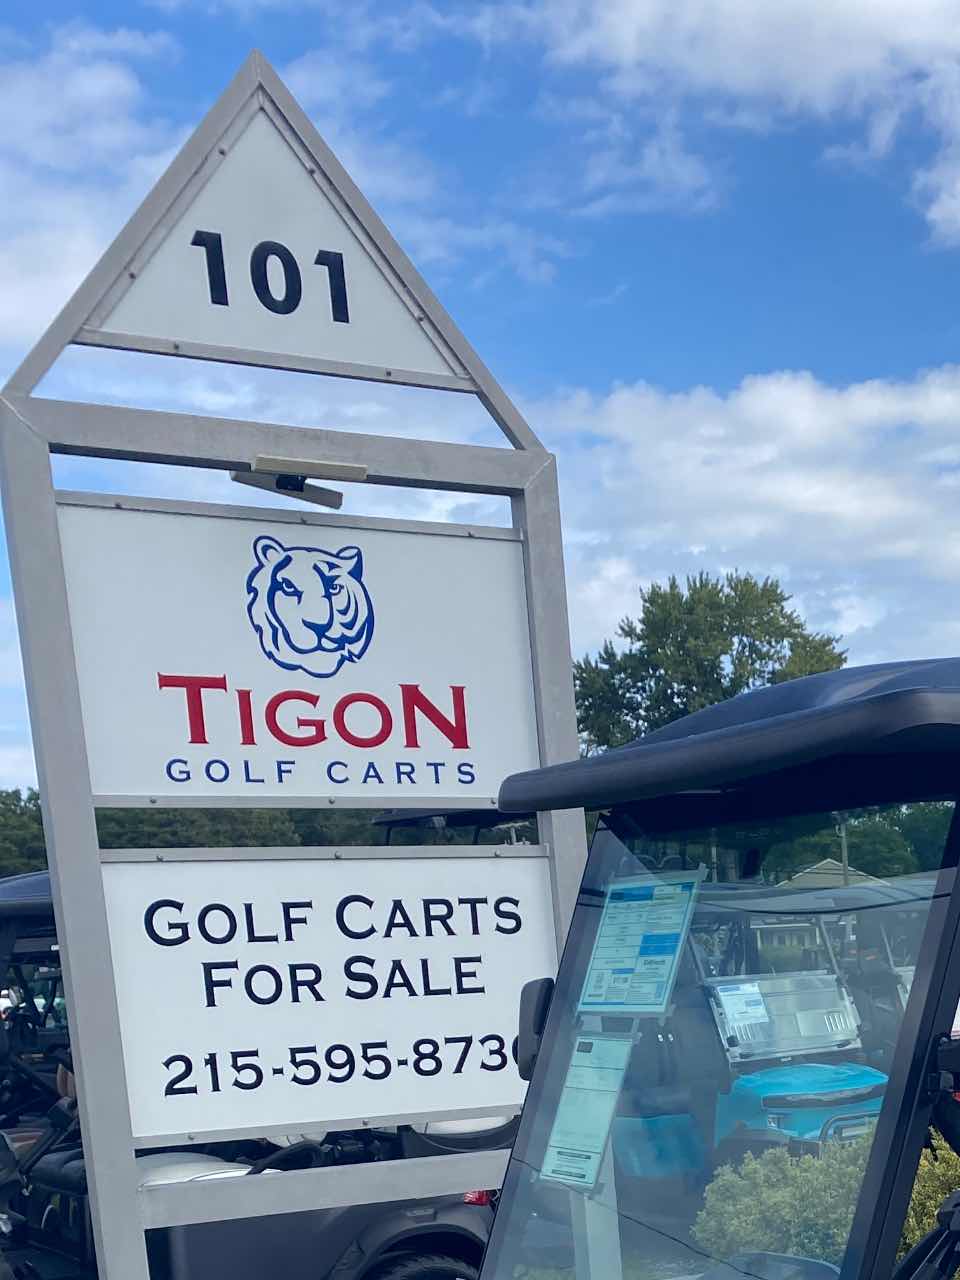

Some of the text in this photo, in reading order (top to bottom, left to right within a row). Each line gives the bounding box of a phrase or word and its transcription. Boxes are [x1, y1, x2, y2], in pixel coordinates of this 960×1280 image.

[190, 229, 350, 324] 101
[157, 671, 471, 750] TIGON
[165, 758, 476, 785] GOLF CARTS
[143, 894, 522, 947] GOLF CARTS
[200, 954, 486, 1008] FOR SALE
[161, 1033, 520, 1097] 215-595-873
